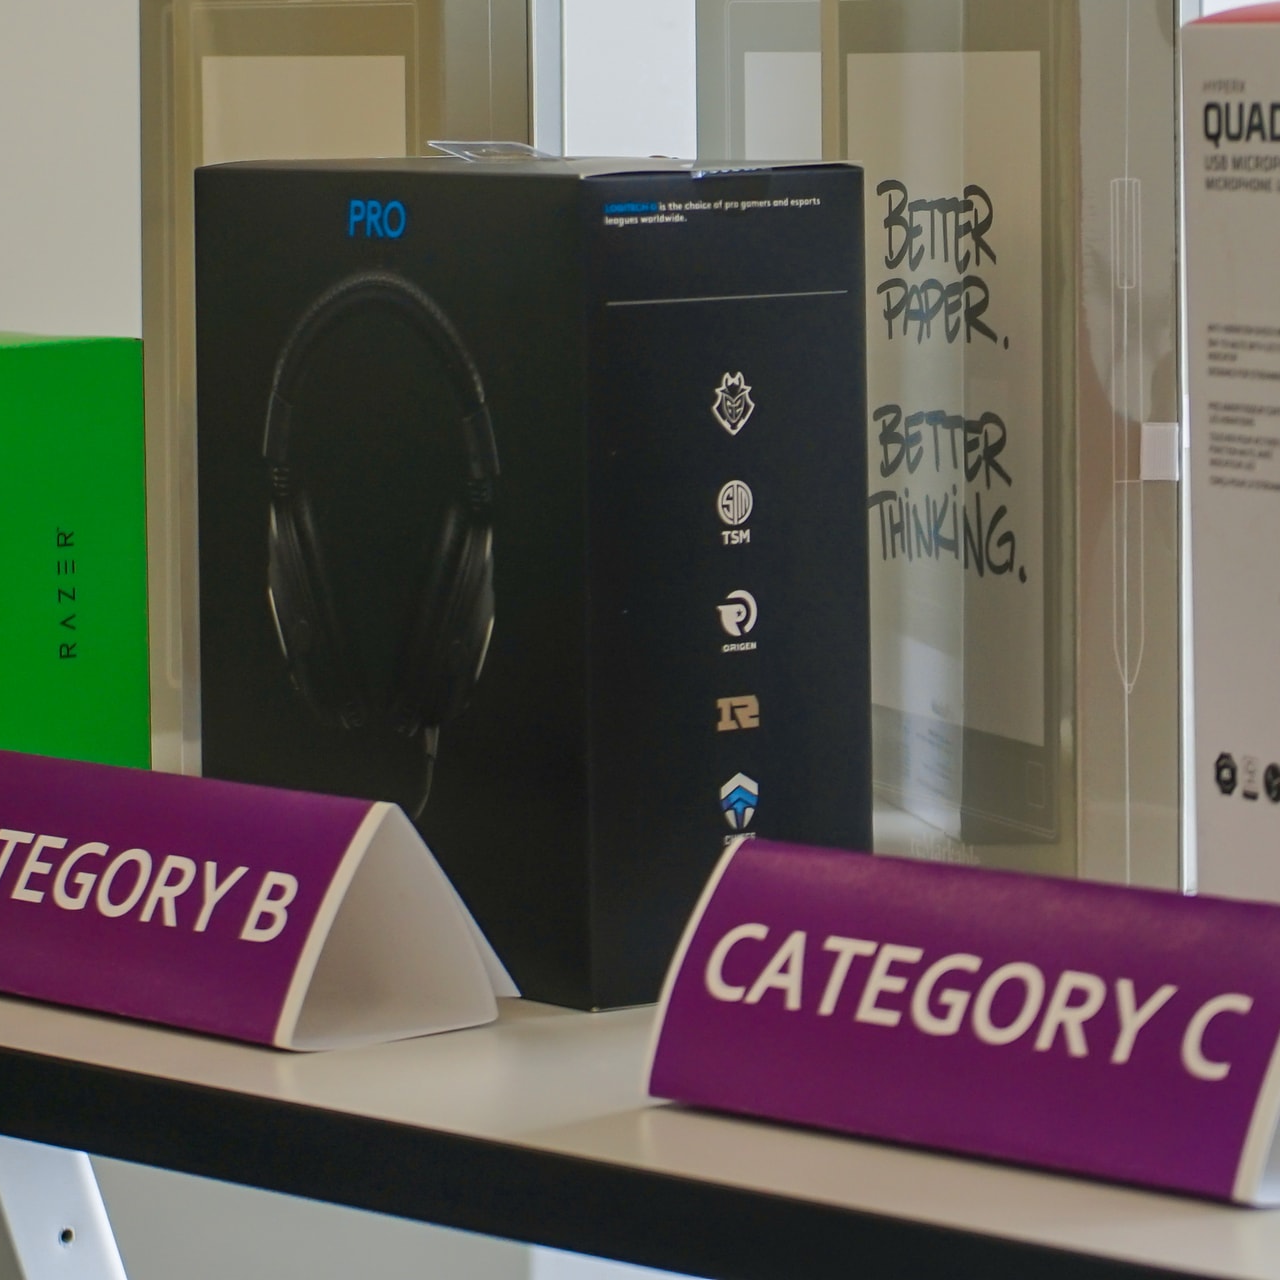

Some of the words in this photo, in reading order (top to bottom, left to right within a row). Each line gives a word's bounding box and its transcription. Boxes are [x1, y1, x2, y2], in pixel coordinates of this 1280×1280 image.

[1204, 154, 1228, 172] USB
[658, 201, 667, 212] is
[668, 200, 683, 211] the
[684, 200, 712, 211] choice
[713, 199, 723, 210] of
[724, 200, 740, 212] pro
[741, 198, 771, 211] gamers
[773, 197, 789, 207] and
[790, 196, 821, 208] esports
[1205, 175, 1272, 193] MICROPHONE
[348, 199, 407, 239] PRO
[605, 214, 639, 227] leagues
[640, 213, 688, 224] worldwide.
[877, 179, 997, 274] BETTER
[877, 275, 1010, 351] PAPER.
[873, 403, 1012, 490] BETTER
[721, 528, 752, 546] TSM
[56, 525, 77, 660] RAZER
[722, 640, 758, 653] ORIGEN
[239, 870, 300, 943] B
[704, 922, 1178, 1065] CATEGORY
[1179, 992, 1254, 1082] C
